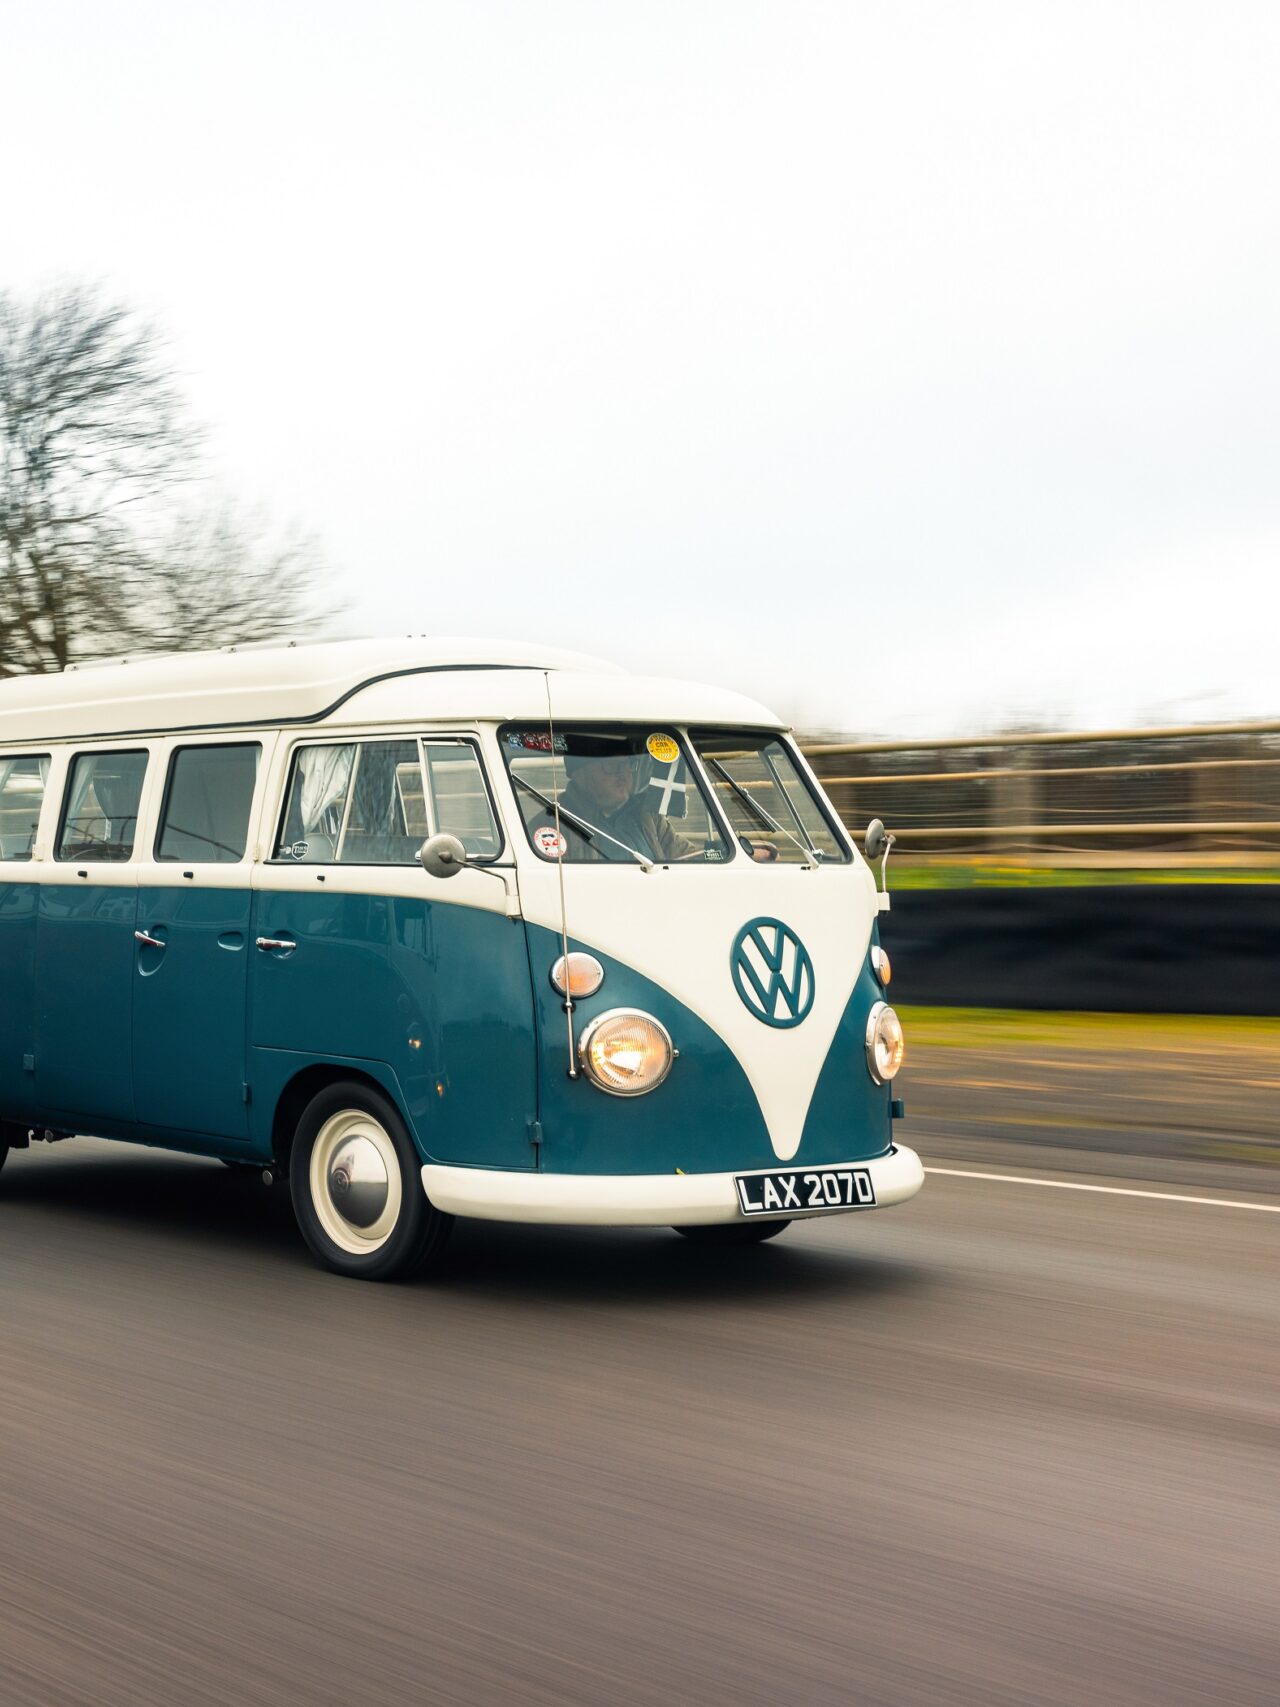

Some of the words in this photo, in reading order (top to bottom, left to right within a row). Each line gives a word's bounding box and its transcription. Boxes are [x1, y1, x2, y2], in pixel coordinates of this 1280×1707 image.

[730, 916, 815, 1029] VW
[738, 1175, 801, 1211] LAX
[803, 1171, 873, 1206] 207D
